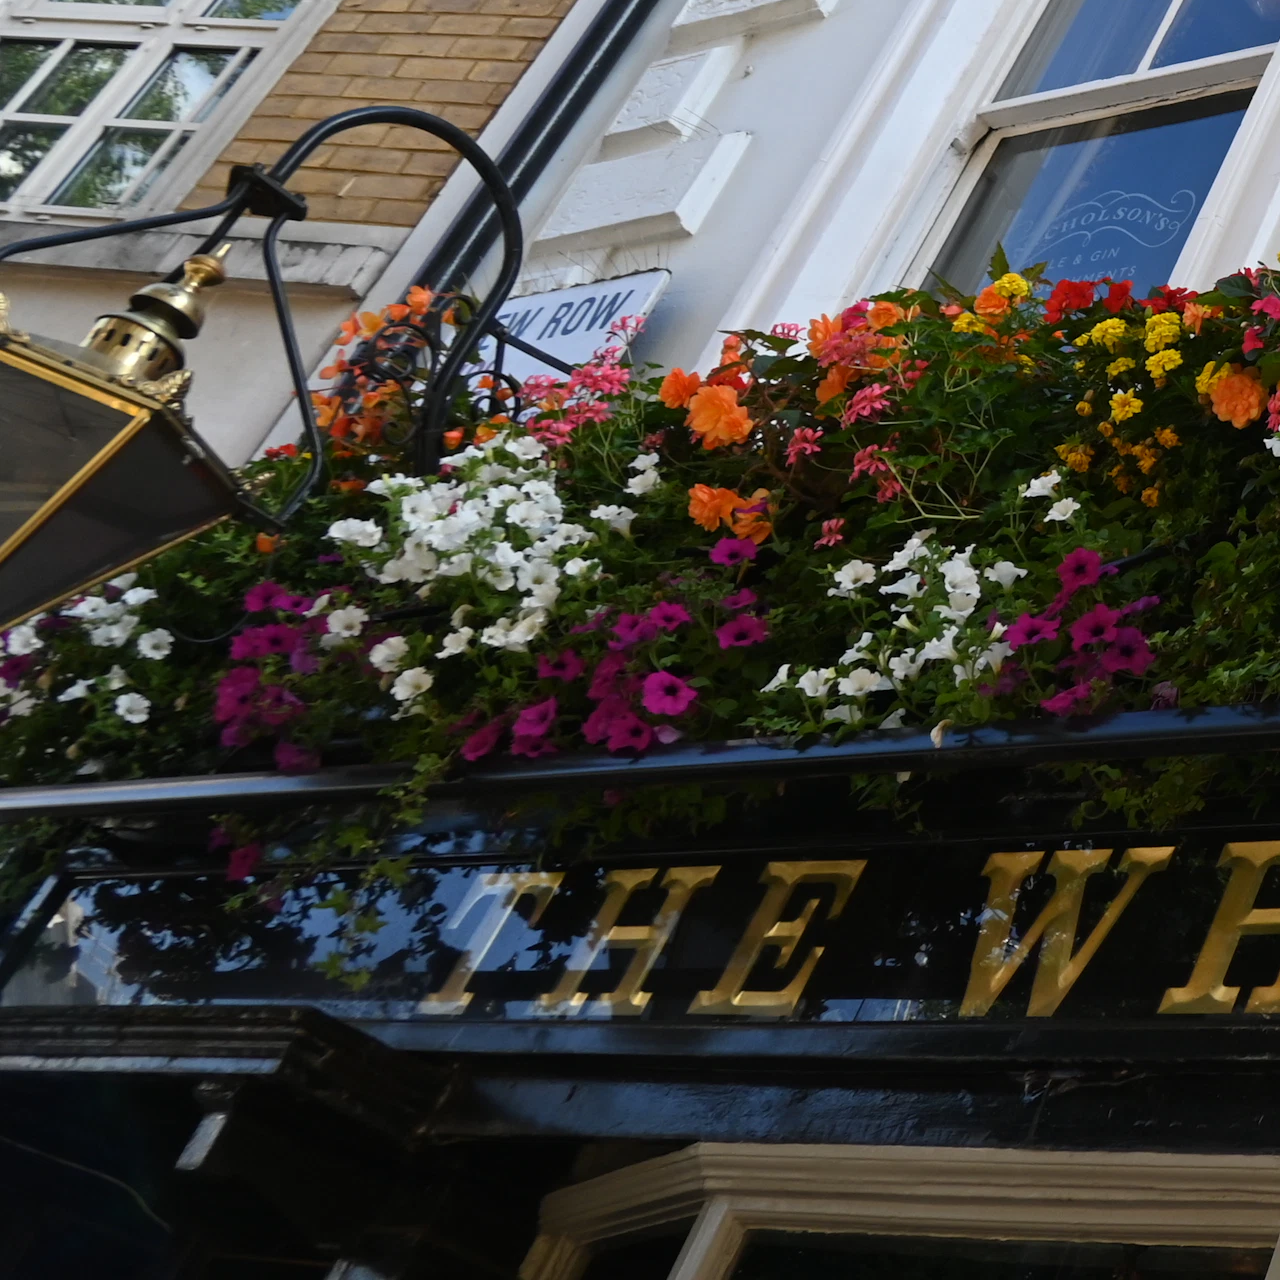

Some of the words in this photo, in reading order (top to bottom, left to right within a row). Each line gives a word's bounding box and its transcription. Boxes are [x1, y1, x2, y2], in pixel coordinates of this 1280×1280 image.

[1090, 247, 1121, 263] GIN
[536, 289, 635, 341] ROW
[417, 859, 868, 1018] THE
